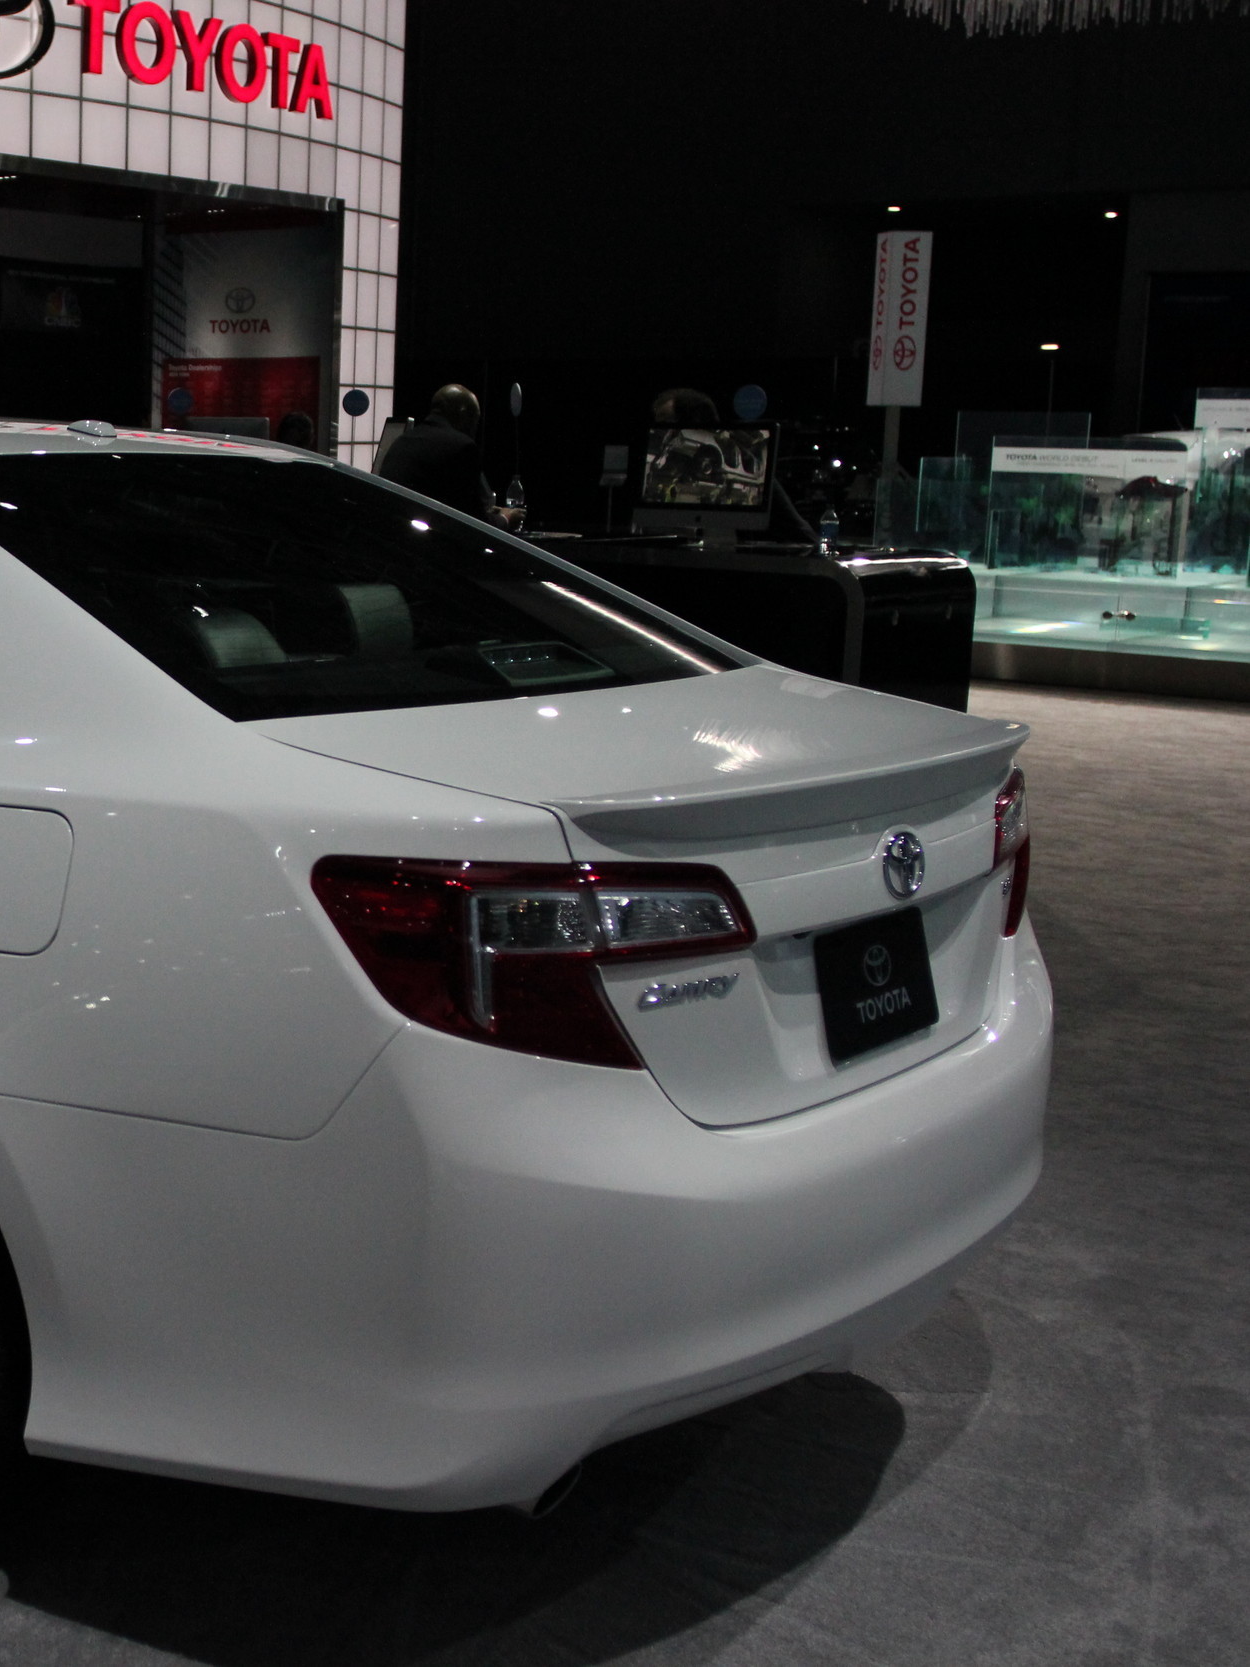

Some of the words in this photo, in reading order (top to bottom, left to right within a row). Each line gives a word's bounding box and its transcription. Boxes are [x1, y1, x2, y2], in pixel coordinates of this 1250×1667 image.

[67, 0, 333, 120] TOYOTA
[876, 238, 889, 330] TOYOTA
[898, 238, 921, 330] TOYOTA
[209, 318, 271, 334] TOYOTA
[1006, 453, 1038, 461] TOYOTA
[855, 986, 913, 1025] TOYOTA
